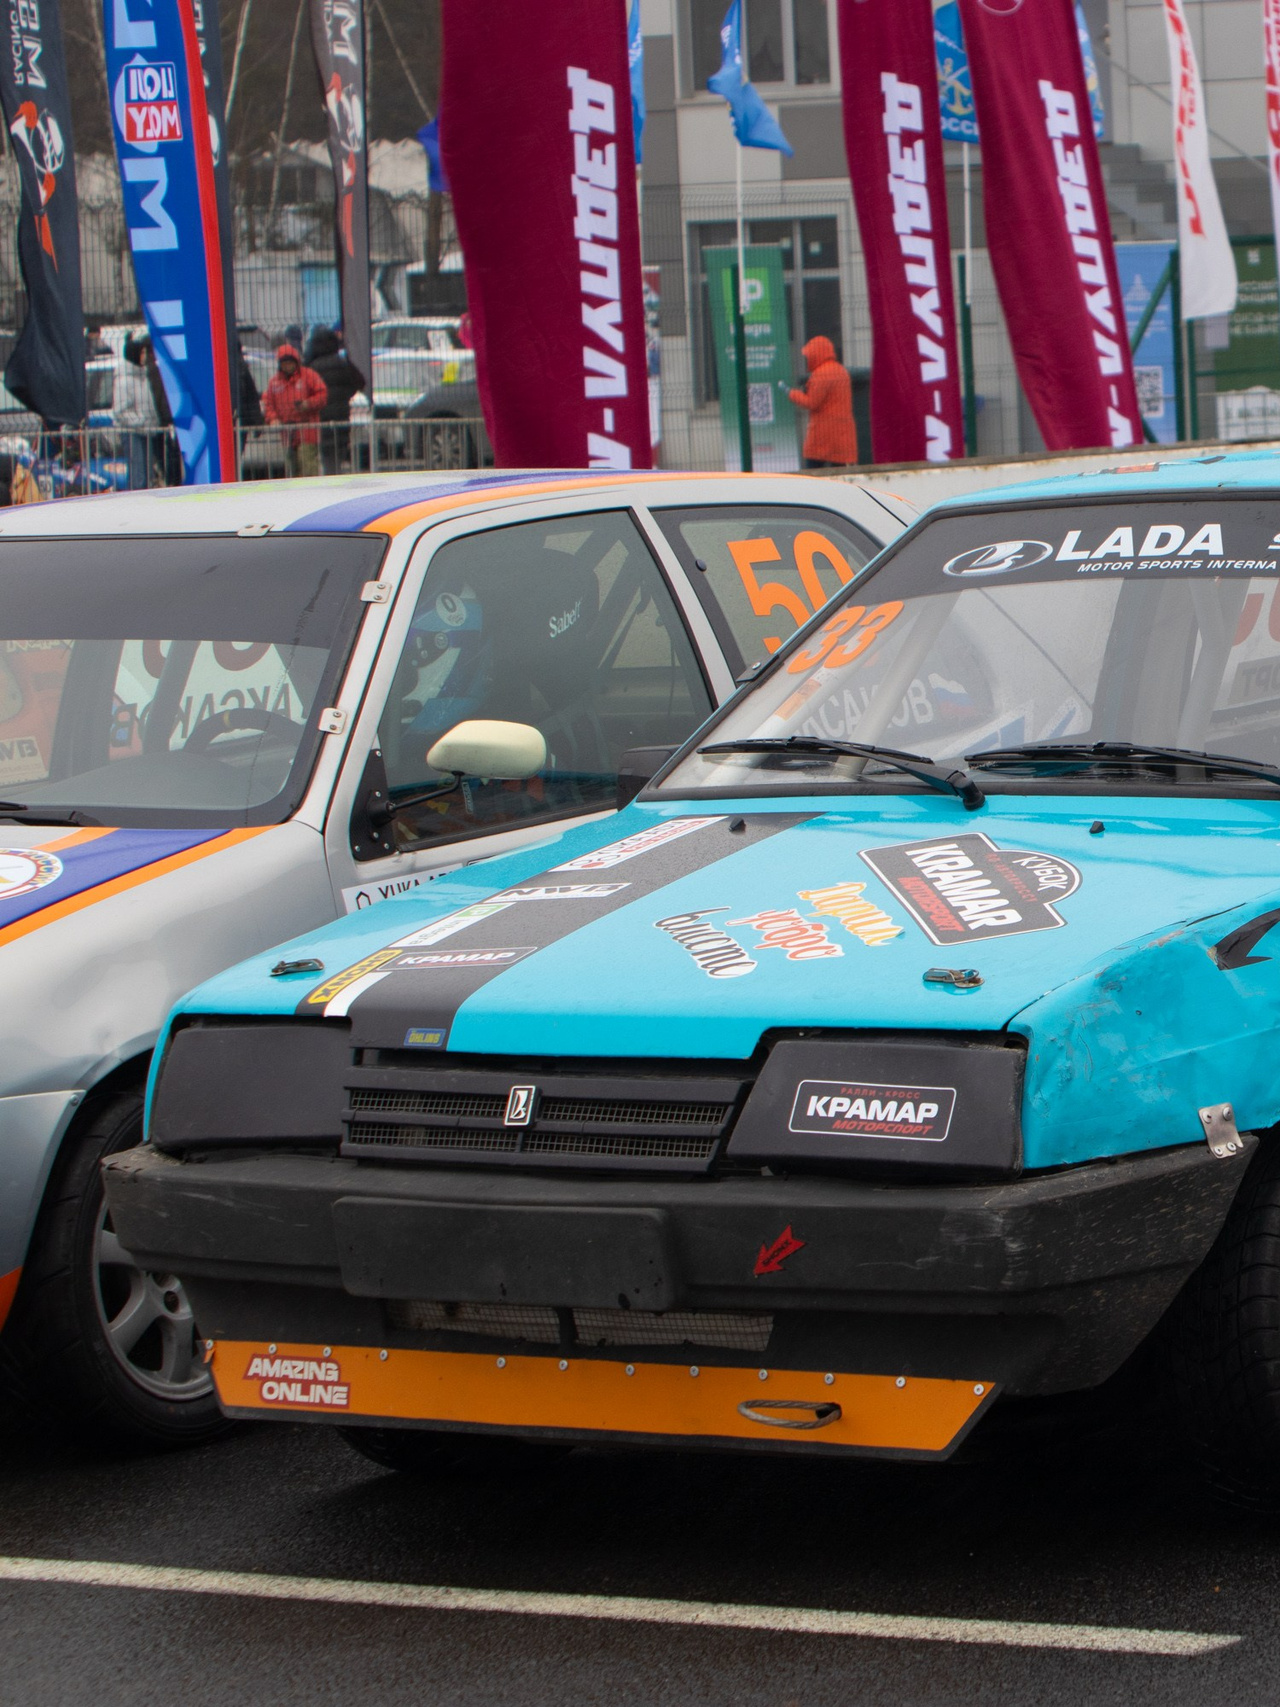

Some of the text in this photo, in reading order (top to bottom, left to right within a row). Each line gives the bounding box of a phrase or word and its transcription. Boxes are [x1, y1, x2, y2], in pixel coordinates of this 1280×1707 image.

[1055, 523, 1224, 561] LADA
[1077, 561, 1132, 573] MOTOR
[1137, 560, 1203, 571] SPORTS
[727, 530, 856, 653] 50
[787, 600, 905, 674] 33
[904, 842, 1022, 931] KRAMAR
[1012, 855, 1069, 892] КУБОК
[398, 951, 517, 966] КРАМАР
[806, 1095, 939, 1124] КРАМАР
[832, 1119, 934, 1135] МОТОРСПОРТ
[247, 1357, 340, 1382] AMAZING
[262, 1381, 349, 1406] ONLINE
